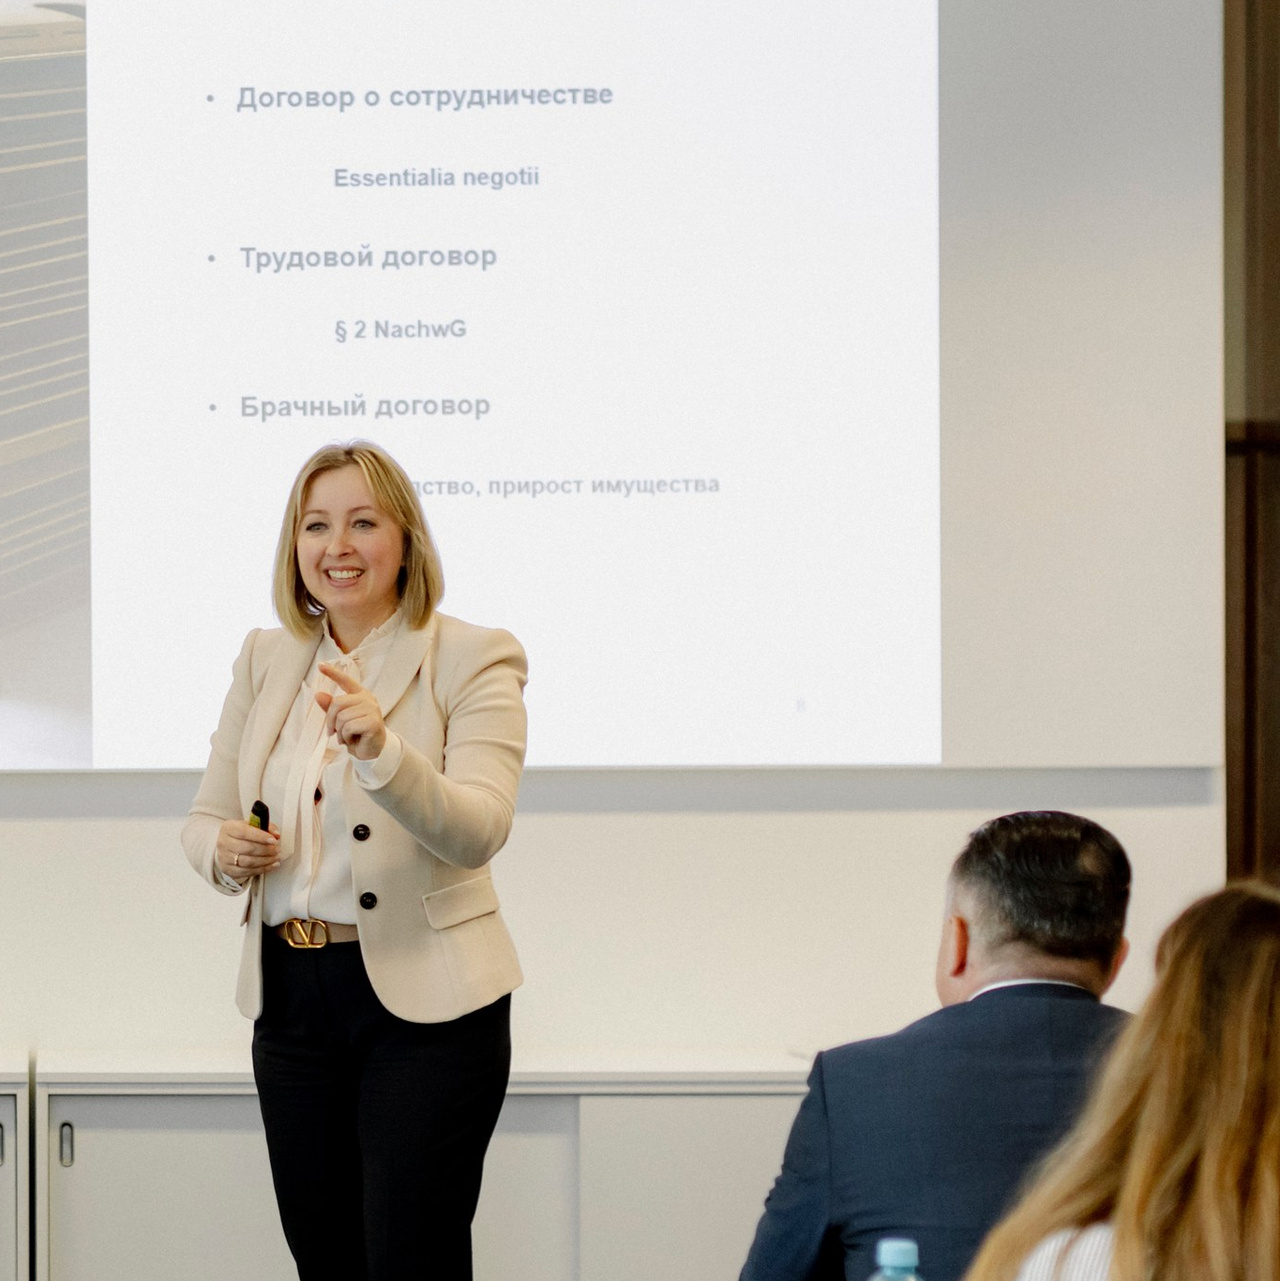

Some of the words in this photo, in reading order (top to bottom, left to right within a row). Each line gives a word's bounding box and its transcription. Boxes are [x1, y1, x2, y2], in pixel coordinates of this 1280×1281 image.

[236, 86, 356, 113] Договор
[363, 89, 381, 108] о
[388, 84, 614, 112] сотрудничестве
[333, 167, 456, 188] Essentialia
[462, 165, 540, 191] negotii
[239, 244, 374, 274] Трудовой
[381, 247, 498, 273] договор
[353, 319, 368, 339] 2
[373, 318, 467, 339] NachwG
[239, 392, 368, 423] Брачный
[374, 397, 491, 422] договор
[487, 479, 583, 500] прирост
[590, 478, 721, 500] имущества
